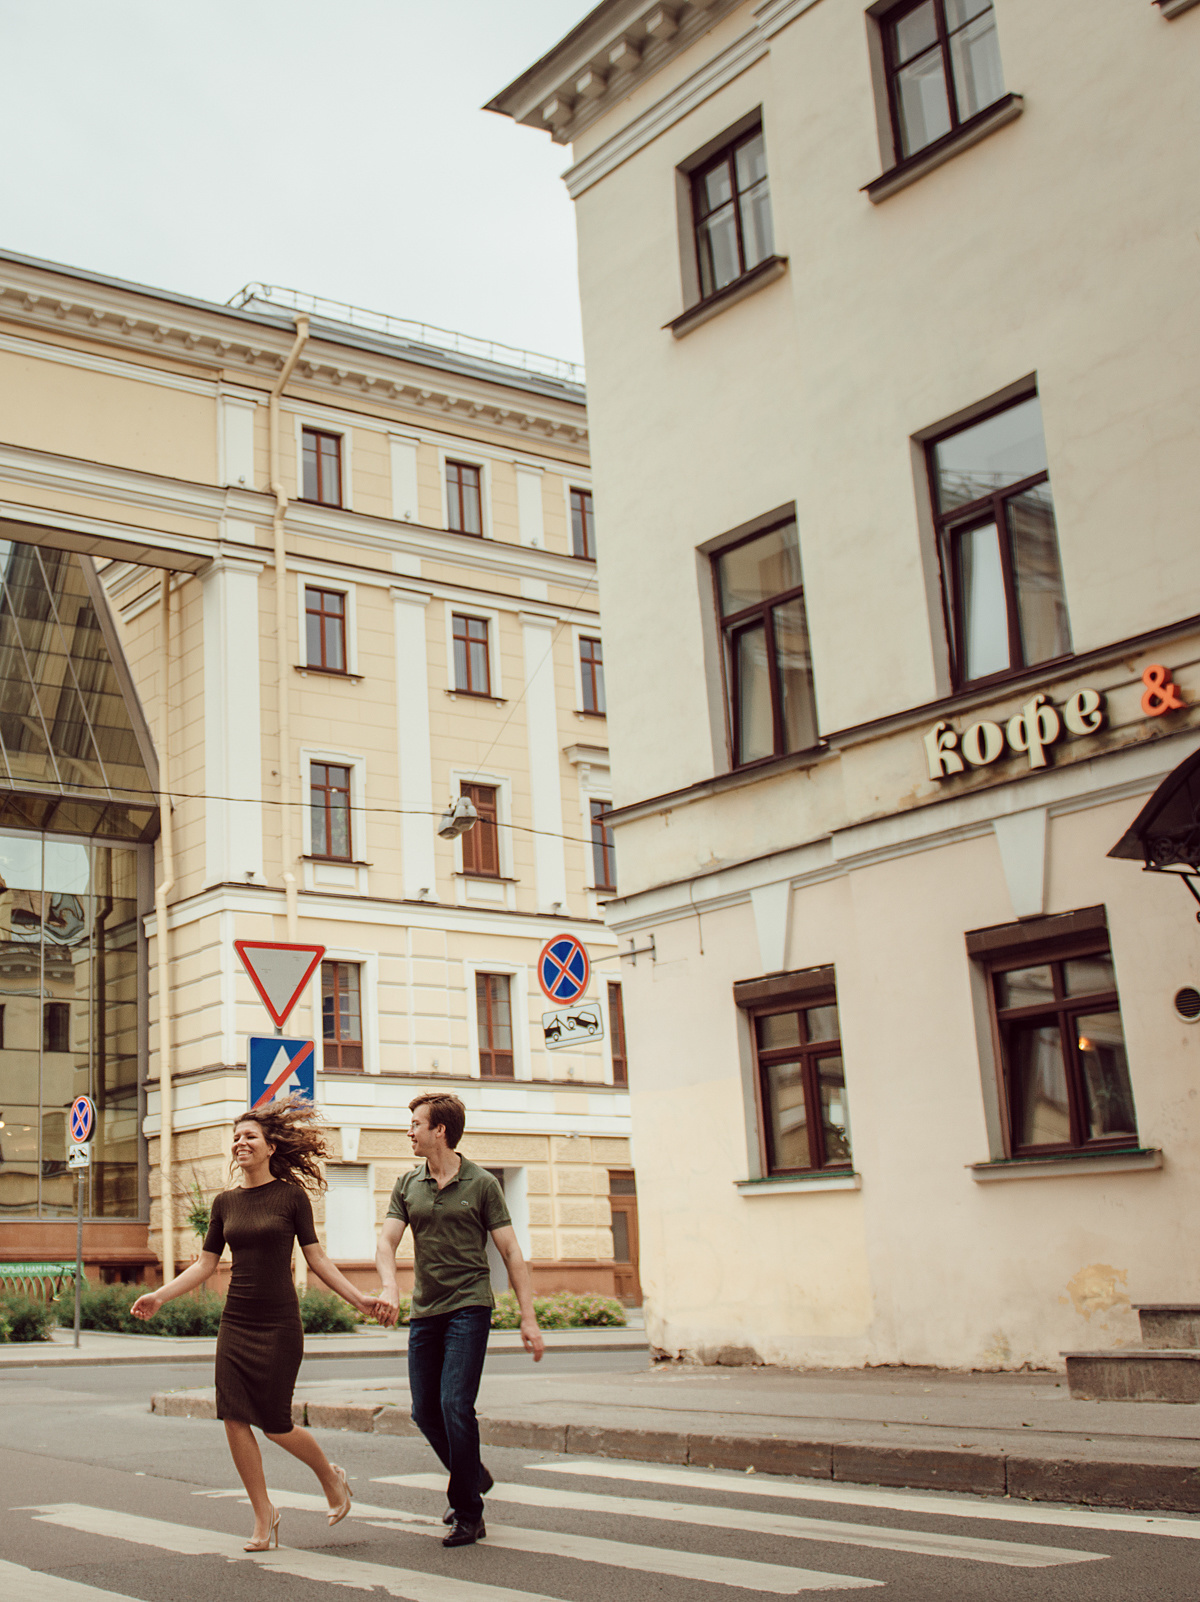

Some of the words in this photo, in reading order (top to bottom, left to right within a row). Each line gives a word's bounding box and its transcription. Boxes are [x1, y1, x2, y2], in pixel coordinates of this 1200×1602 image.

[923, 687, 1102, 781] кофе
[1141, 664, 1187, 717] &
[25, 1265, 42, 1273] НАМ
